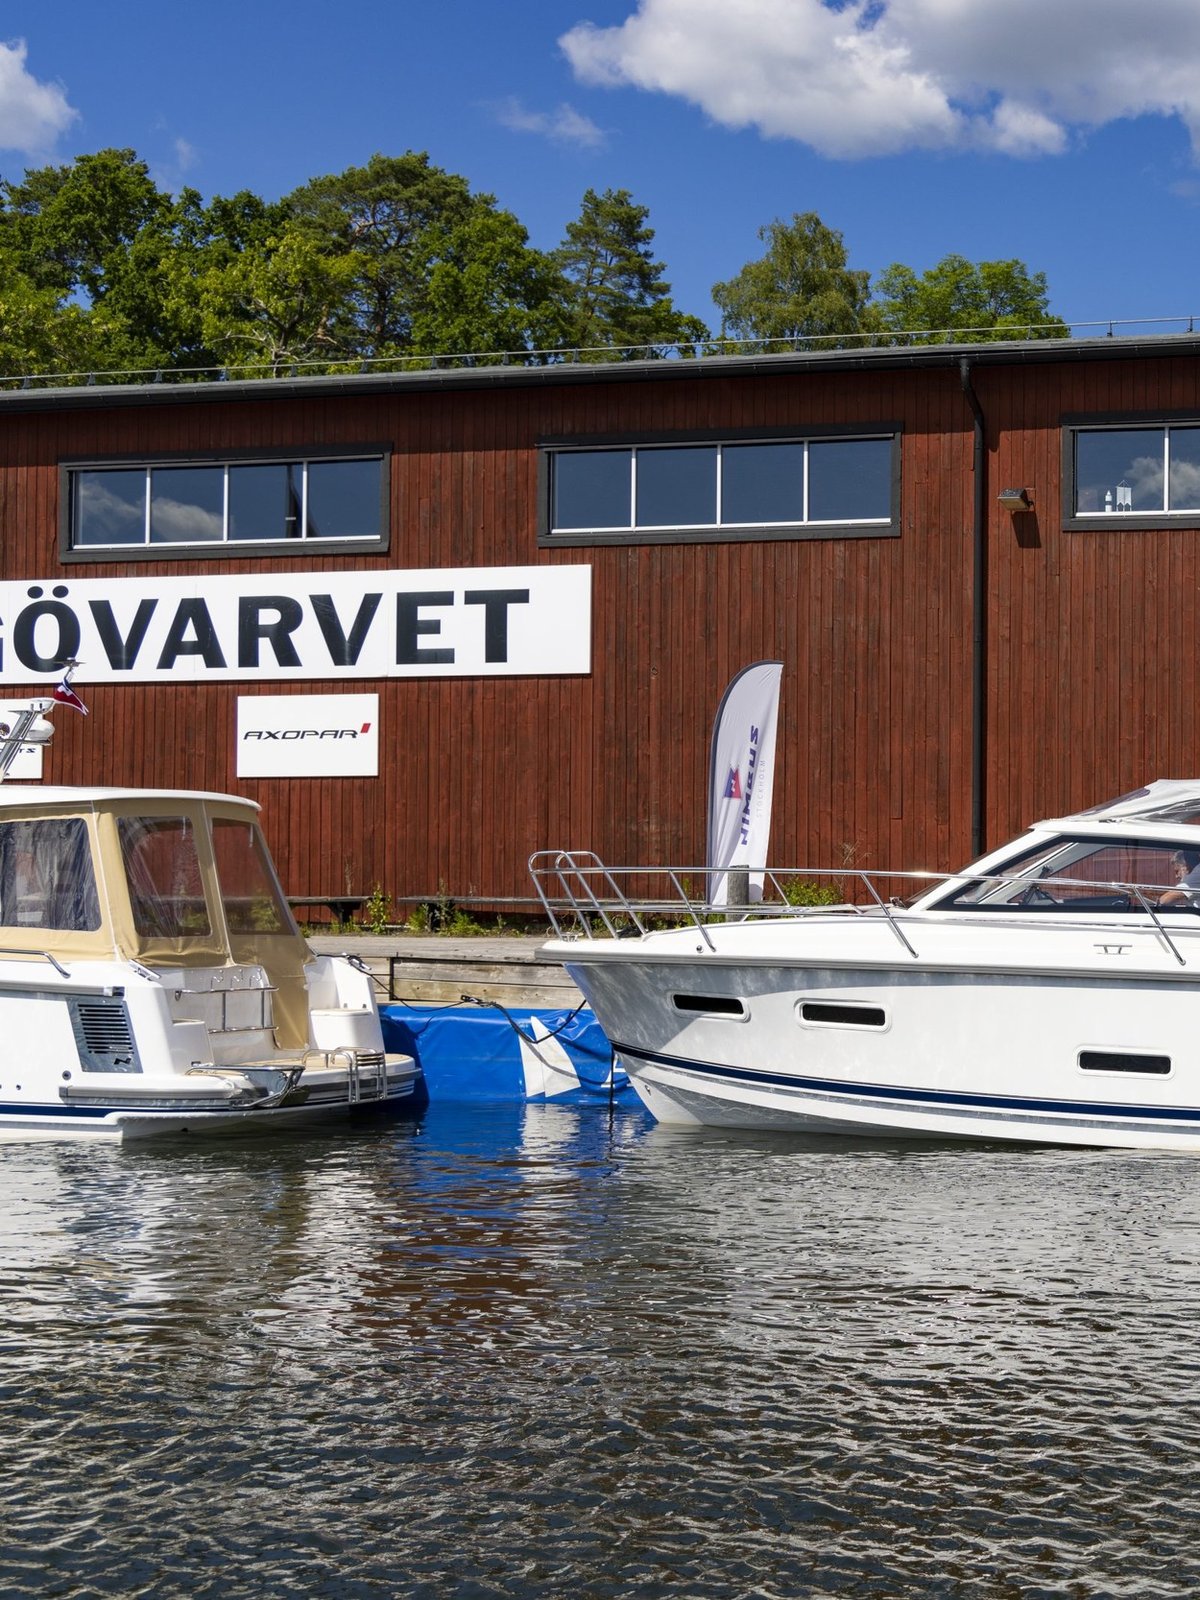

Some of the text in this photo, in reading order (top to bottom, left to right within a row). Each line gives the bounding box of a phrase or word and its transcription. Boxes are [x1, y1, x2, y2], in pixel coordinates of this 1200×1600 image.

[0, 584, 530, 674] ÖVARVET
[243, 729, 358, 740] AXOPAR
[741, 725, 759, 845] NIMBUS
[756, 760, 766, 818] STOCKHOLM
